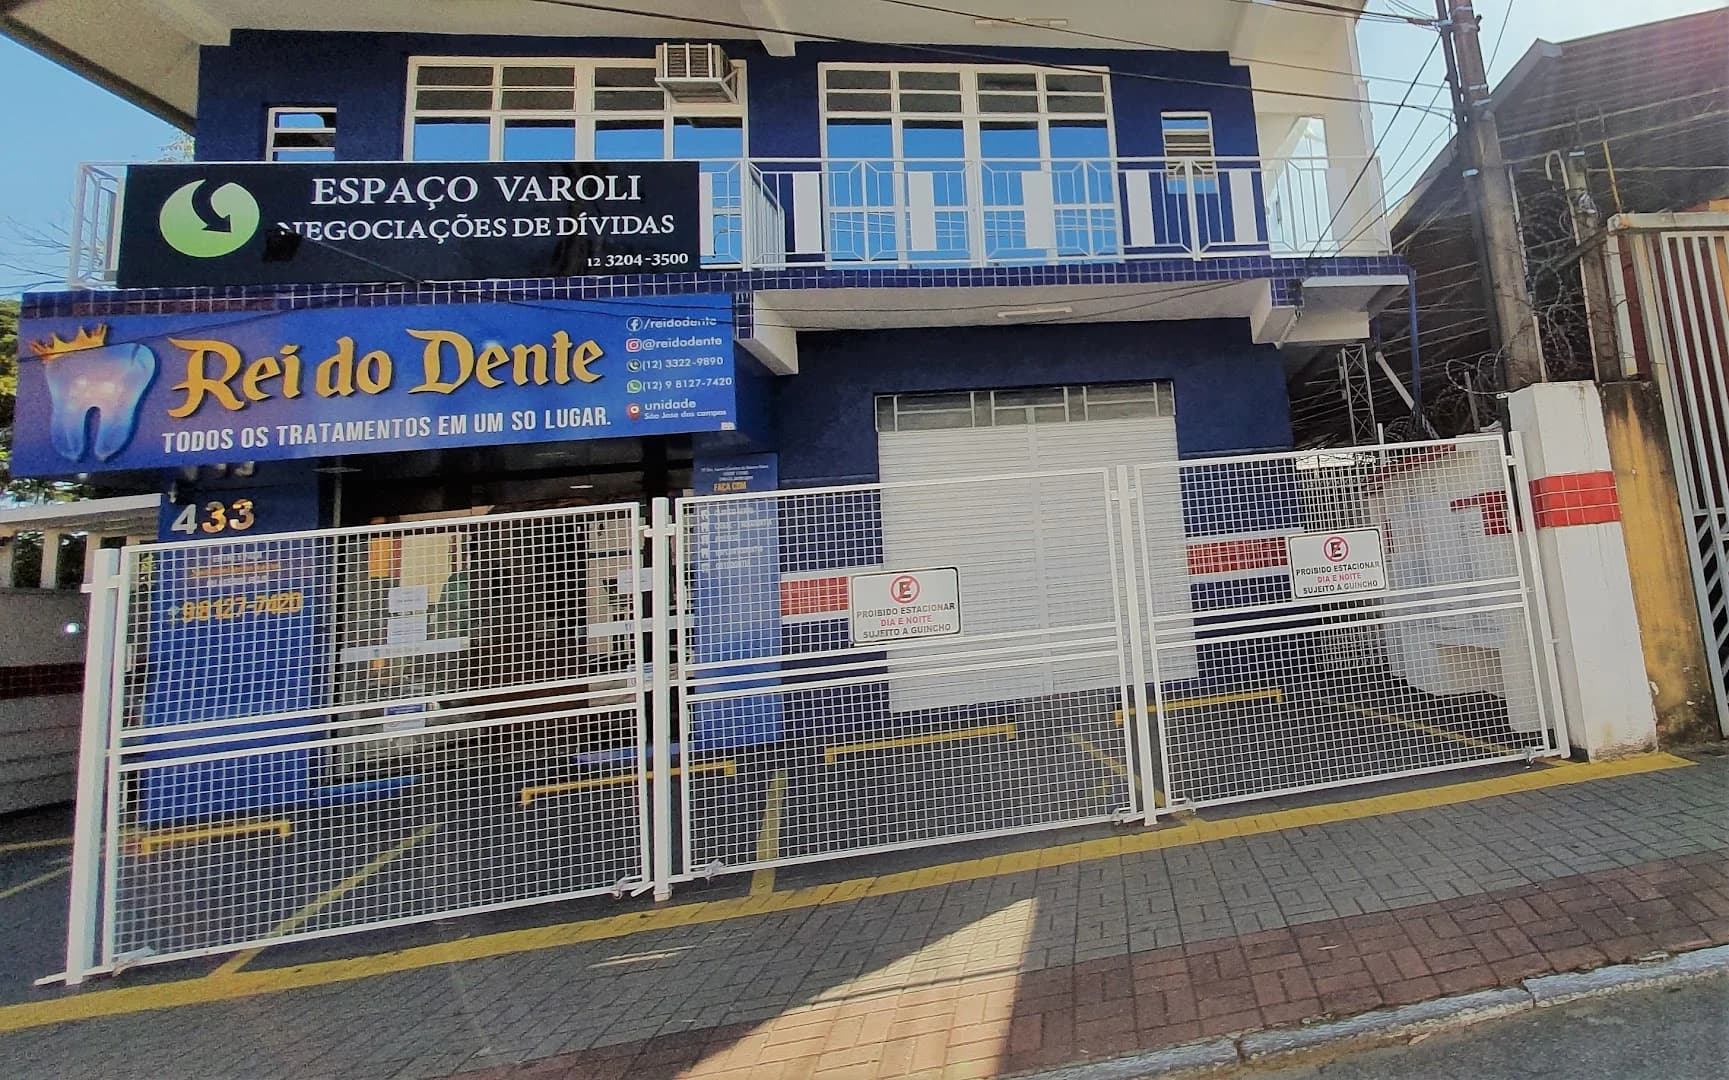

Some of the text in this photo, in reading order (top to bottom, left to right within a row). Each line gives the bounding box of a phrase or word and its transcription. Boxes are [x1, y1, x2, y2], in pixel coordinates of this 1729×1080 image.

[311, 175, 641, 210] ESPAÇO VAROLI
[512, 217, 551, 237] DE
[556, 211, 675, 236] DÍVIDAS
[587, 253, 689, 267] 12 3204-3500
[642, 336, 723, 351] @reidodente
[642, 356, 724, 371] (12) 3322-9890
[168, 329, 604, 418] Rei do Dente
[642, 377, 733, 392] (12) 9 8127-7420
[644, 398, 697, 411] unidade
[162, 406, 612, 454] TODOS OS TRATAMENTOS EM UM SO LUGAR.
[171, 498, 255, 535] 433
[1296, 561, 1380, 576] PROIBIDO ESTACIONAR
[1317, 572, 1362, 584] DIA E NOITE
[1303, 580, 1378, 594] SUJEITO A GUINCHO
[856, 602, 956, 619] PROIBIDO ESTACIONAR
[880, 614, 932, 627] DIA E NOITE
[863, 623, 951, 639] SUJEITO A GUINCHO
